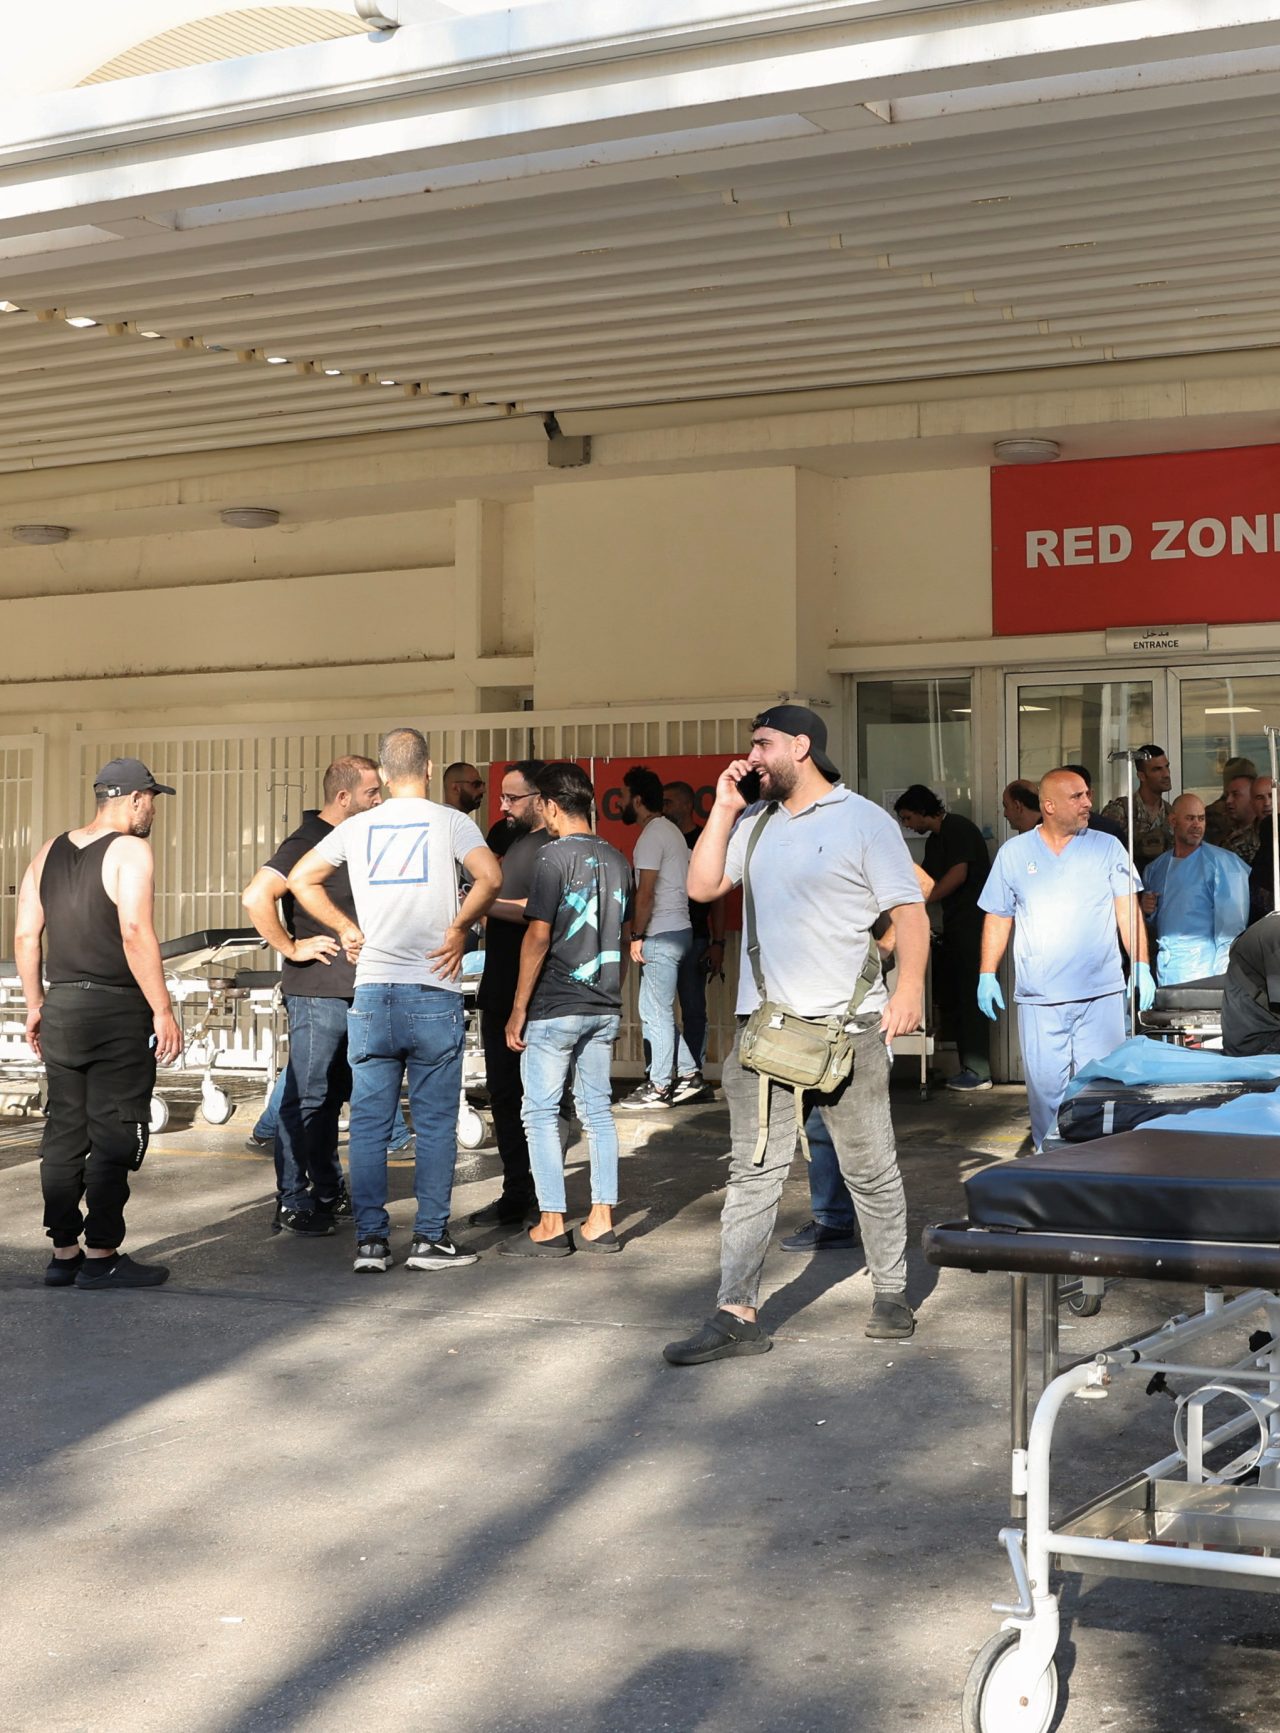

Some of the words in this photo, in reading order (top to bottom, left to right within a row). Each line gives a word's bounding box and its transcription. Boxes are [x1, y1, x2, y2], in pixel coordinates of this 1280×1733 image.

[1026, 524, 1133, 568] RED
[1142, 630, 1169, 639] مدخل
[1133, 640, 1179, 649] ENTRANCE
